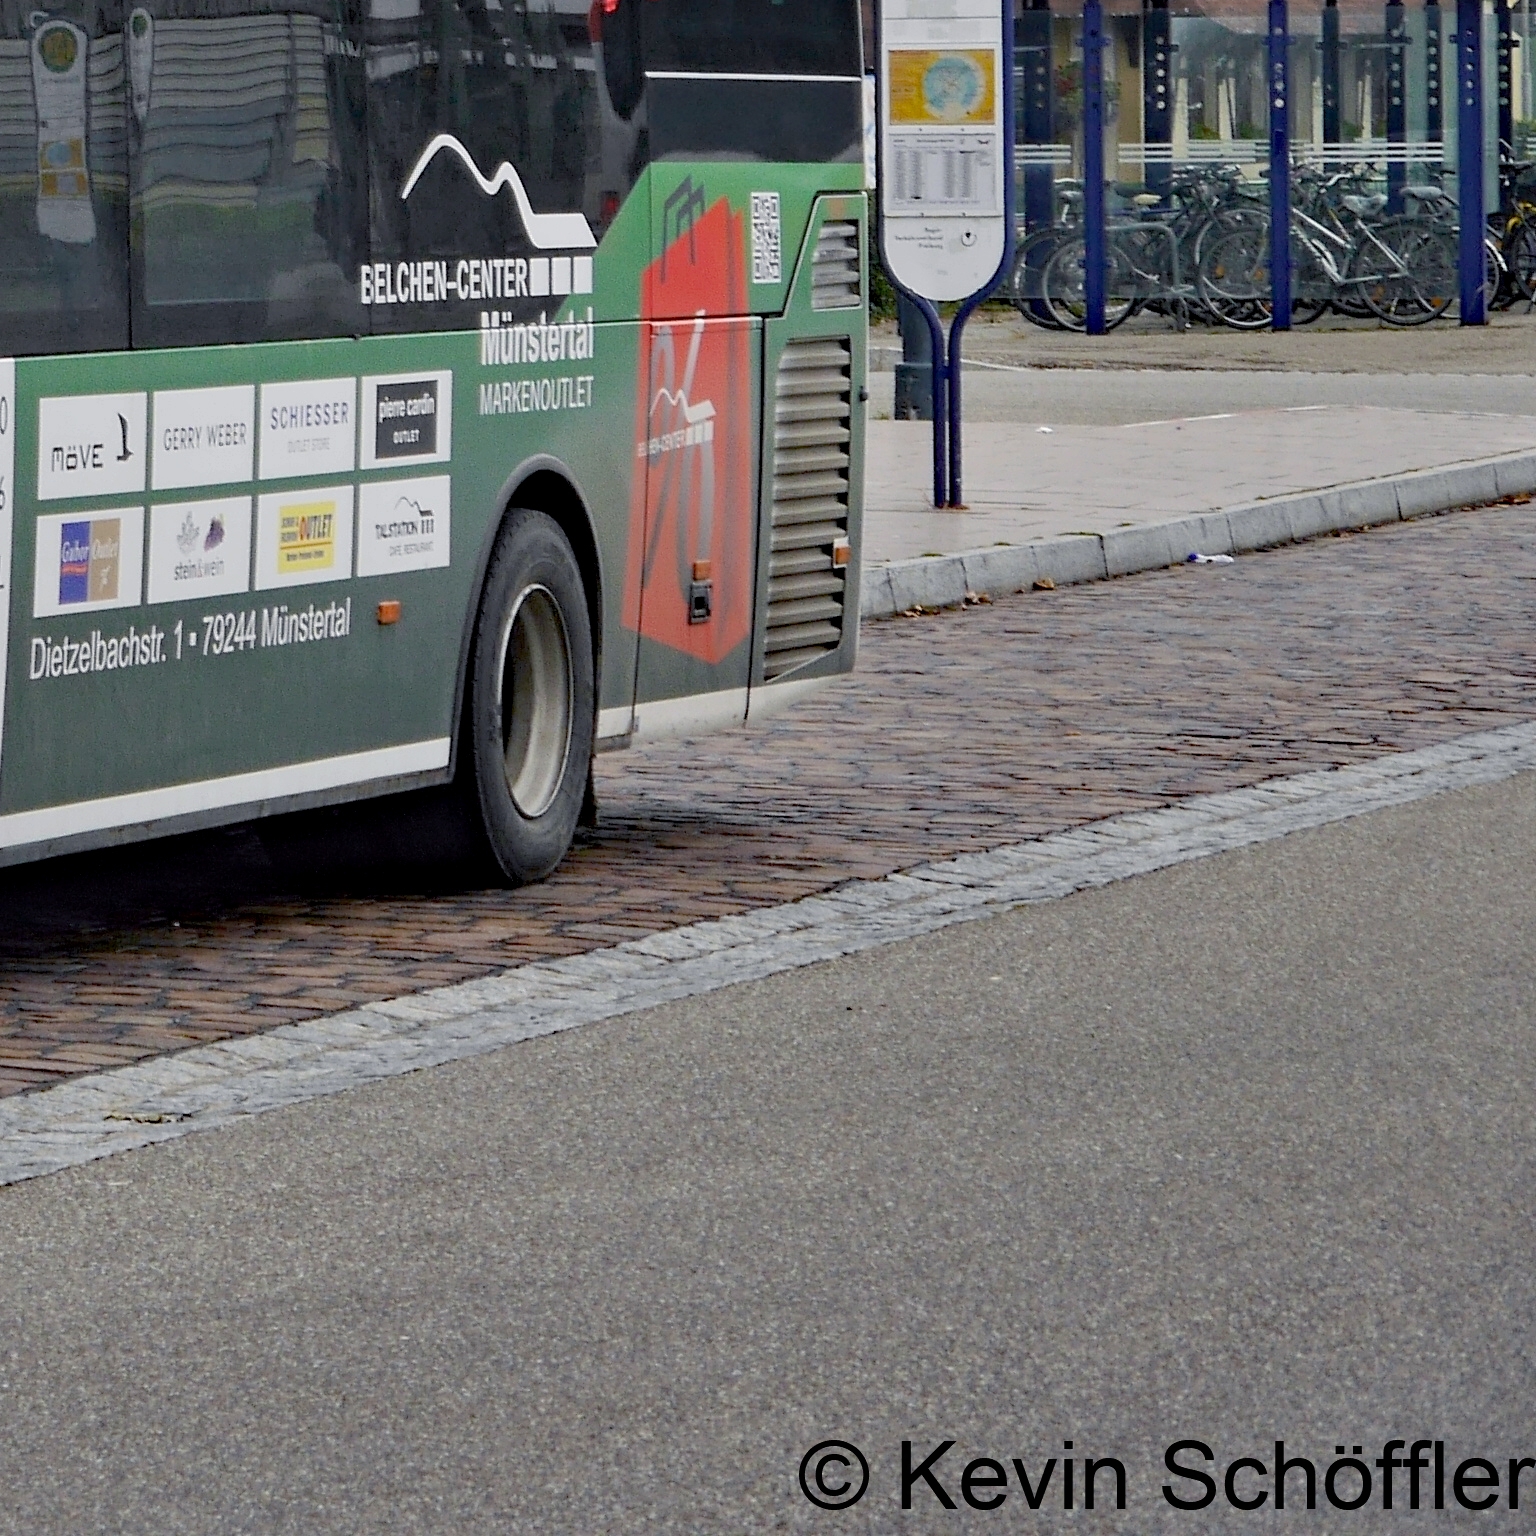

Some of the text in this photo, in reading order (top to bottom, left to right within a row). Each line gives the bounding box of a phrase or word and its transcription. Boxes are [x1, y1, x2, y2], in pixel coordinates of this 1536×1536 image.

[360, 259, 529, 305] BELCHEN-CENTER
[480, 306, 595, 366] Münstertal
[270, 401, 349, 430] SCHIESSER
[379, 392, 436, 423] pierre cardin
[479, 375, 595, 416] MARKENOUTLET
[163, 422, 247, 452] GERRY WEBER
[29, 596, 352, 680] Dietzelbachstr. 1 79244 Münstertal
